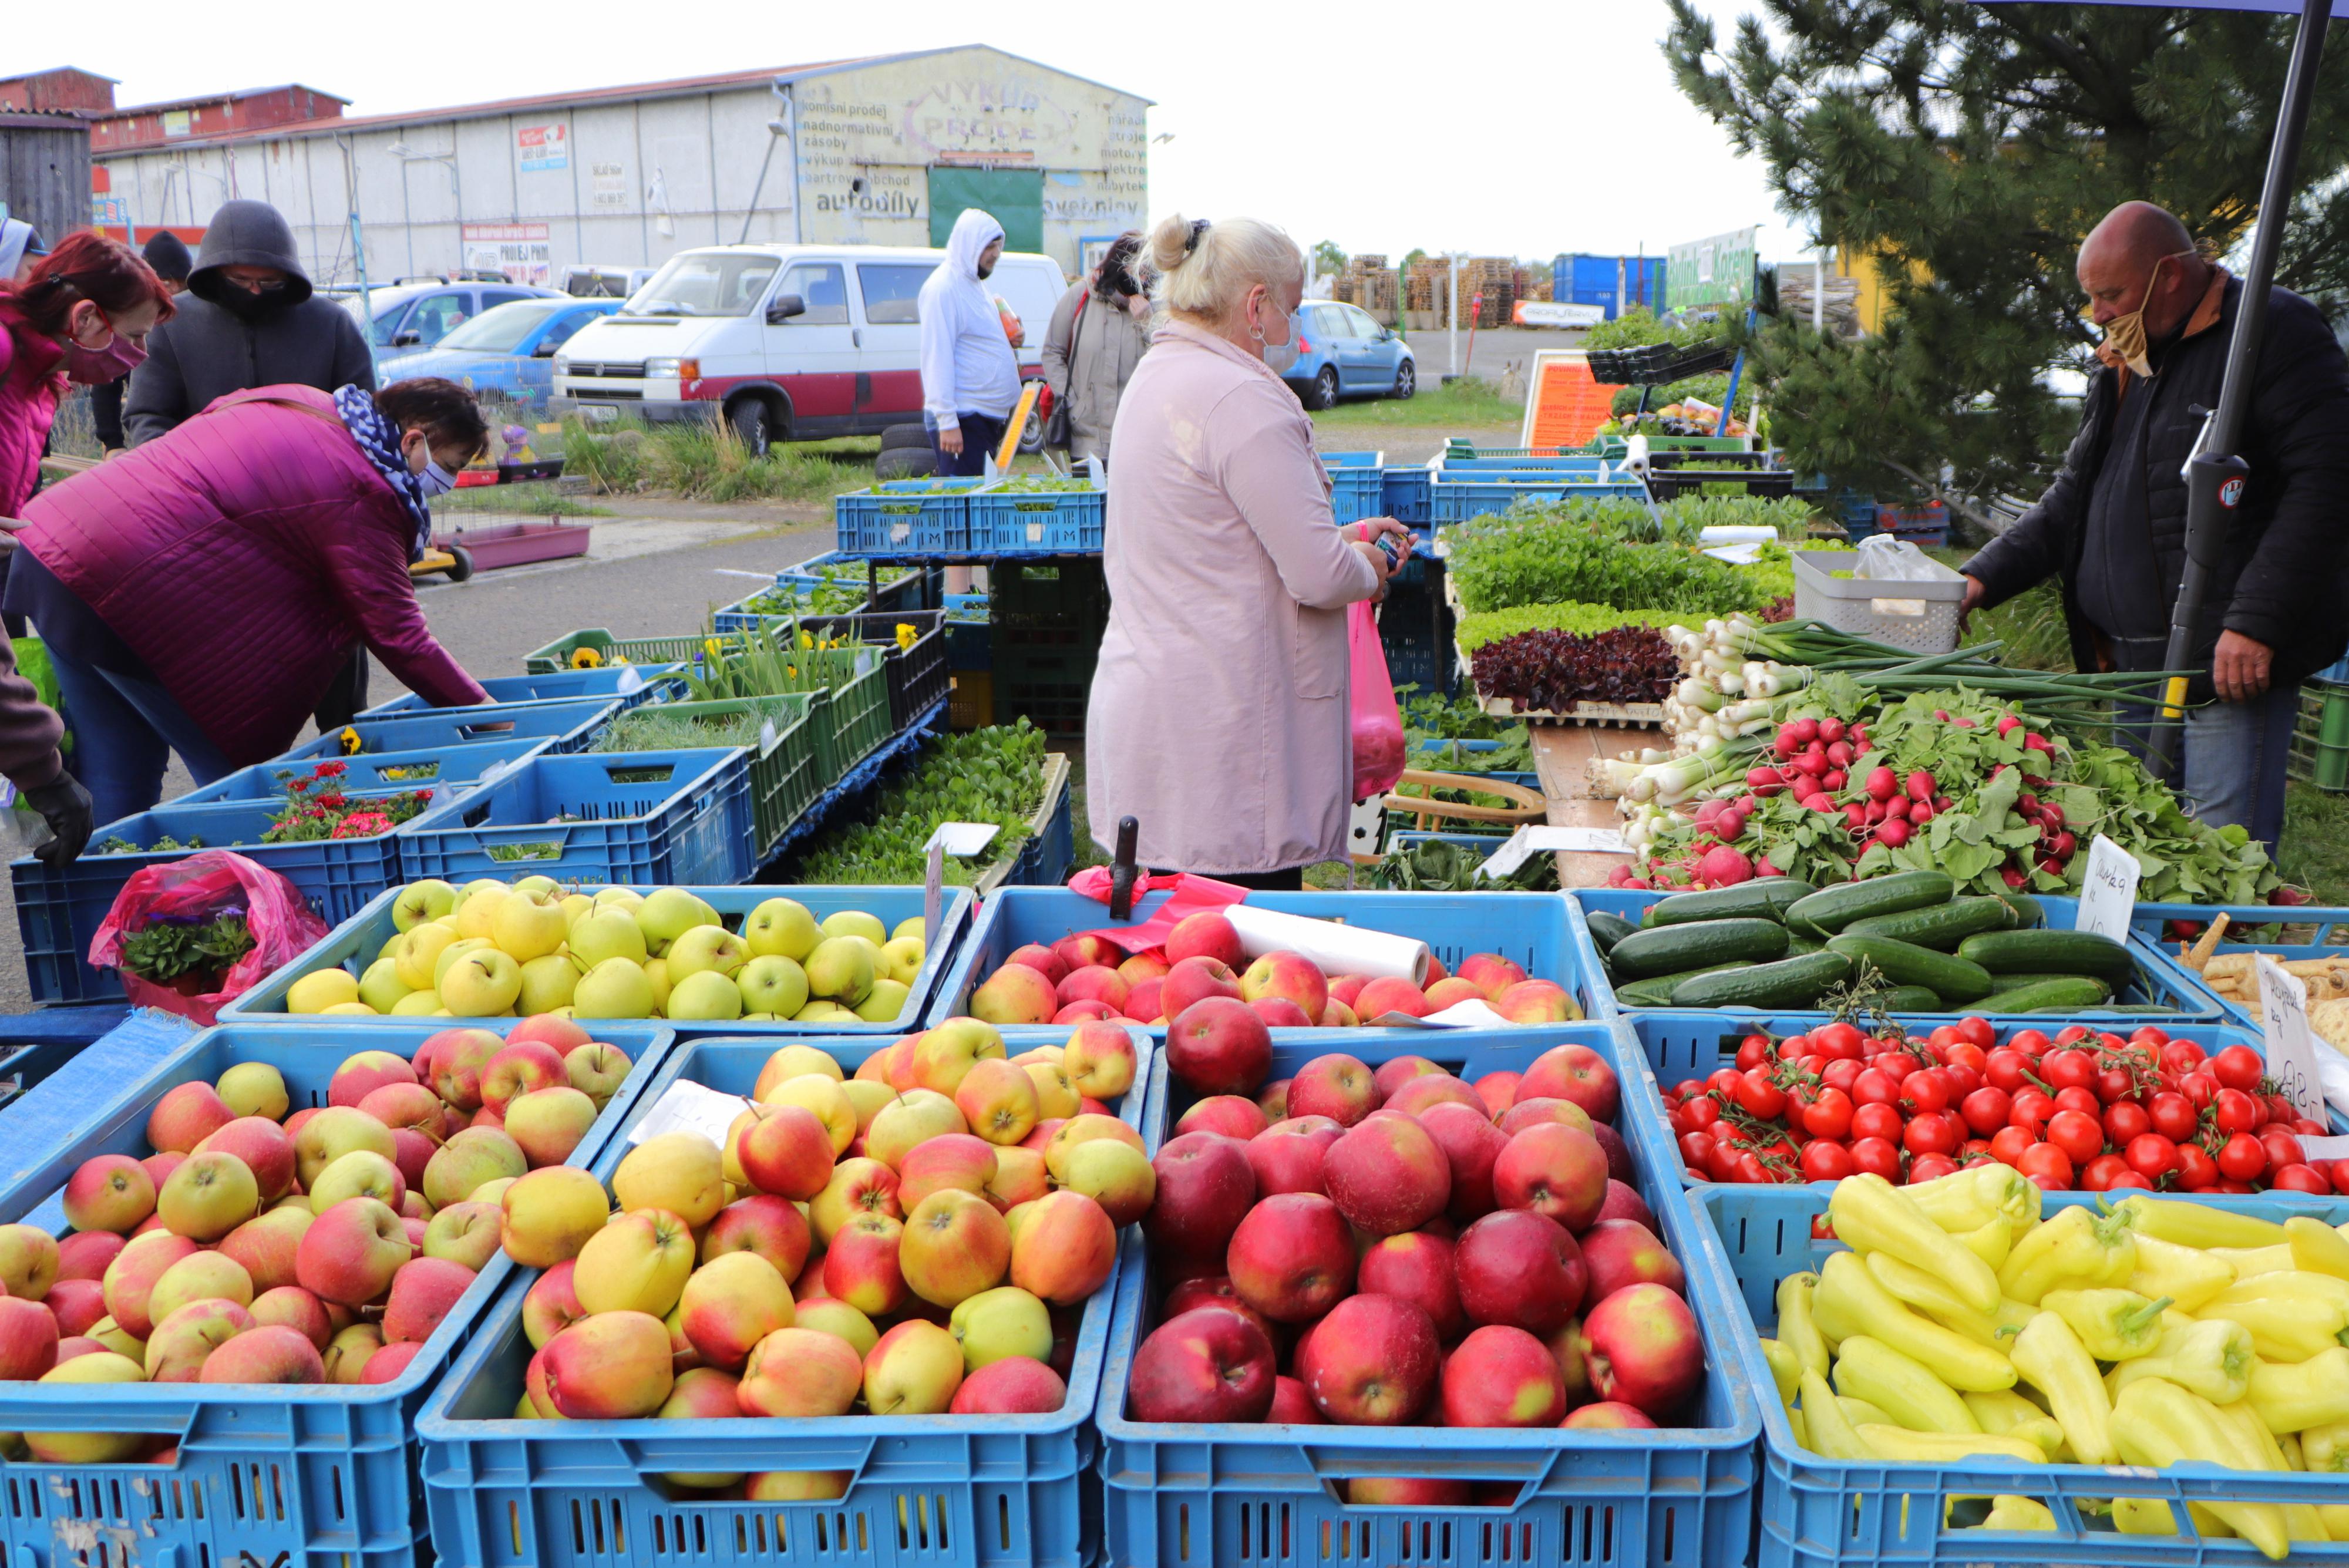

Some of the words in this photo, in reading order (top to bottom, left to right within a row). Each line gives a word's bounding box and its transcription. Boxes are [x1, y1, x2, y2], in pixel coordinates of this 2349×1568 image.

[850, 103, 887, 119] prodej
[804, 135, 847, 150] zásoby
[806, 153, 844, 167] výkup
[1101, 148, 1144, 161] motory
[1103, 163, 1145, 175] elektro
[817, 189, 920, 217] autodíly
[500, 244, 528, 261] PRODEJ
[531, 244, 548, 261] PHM
[1668, 245, 1701, 288] Bylink
